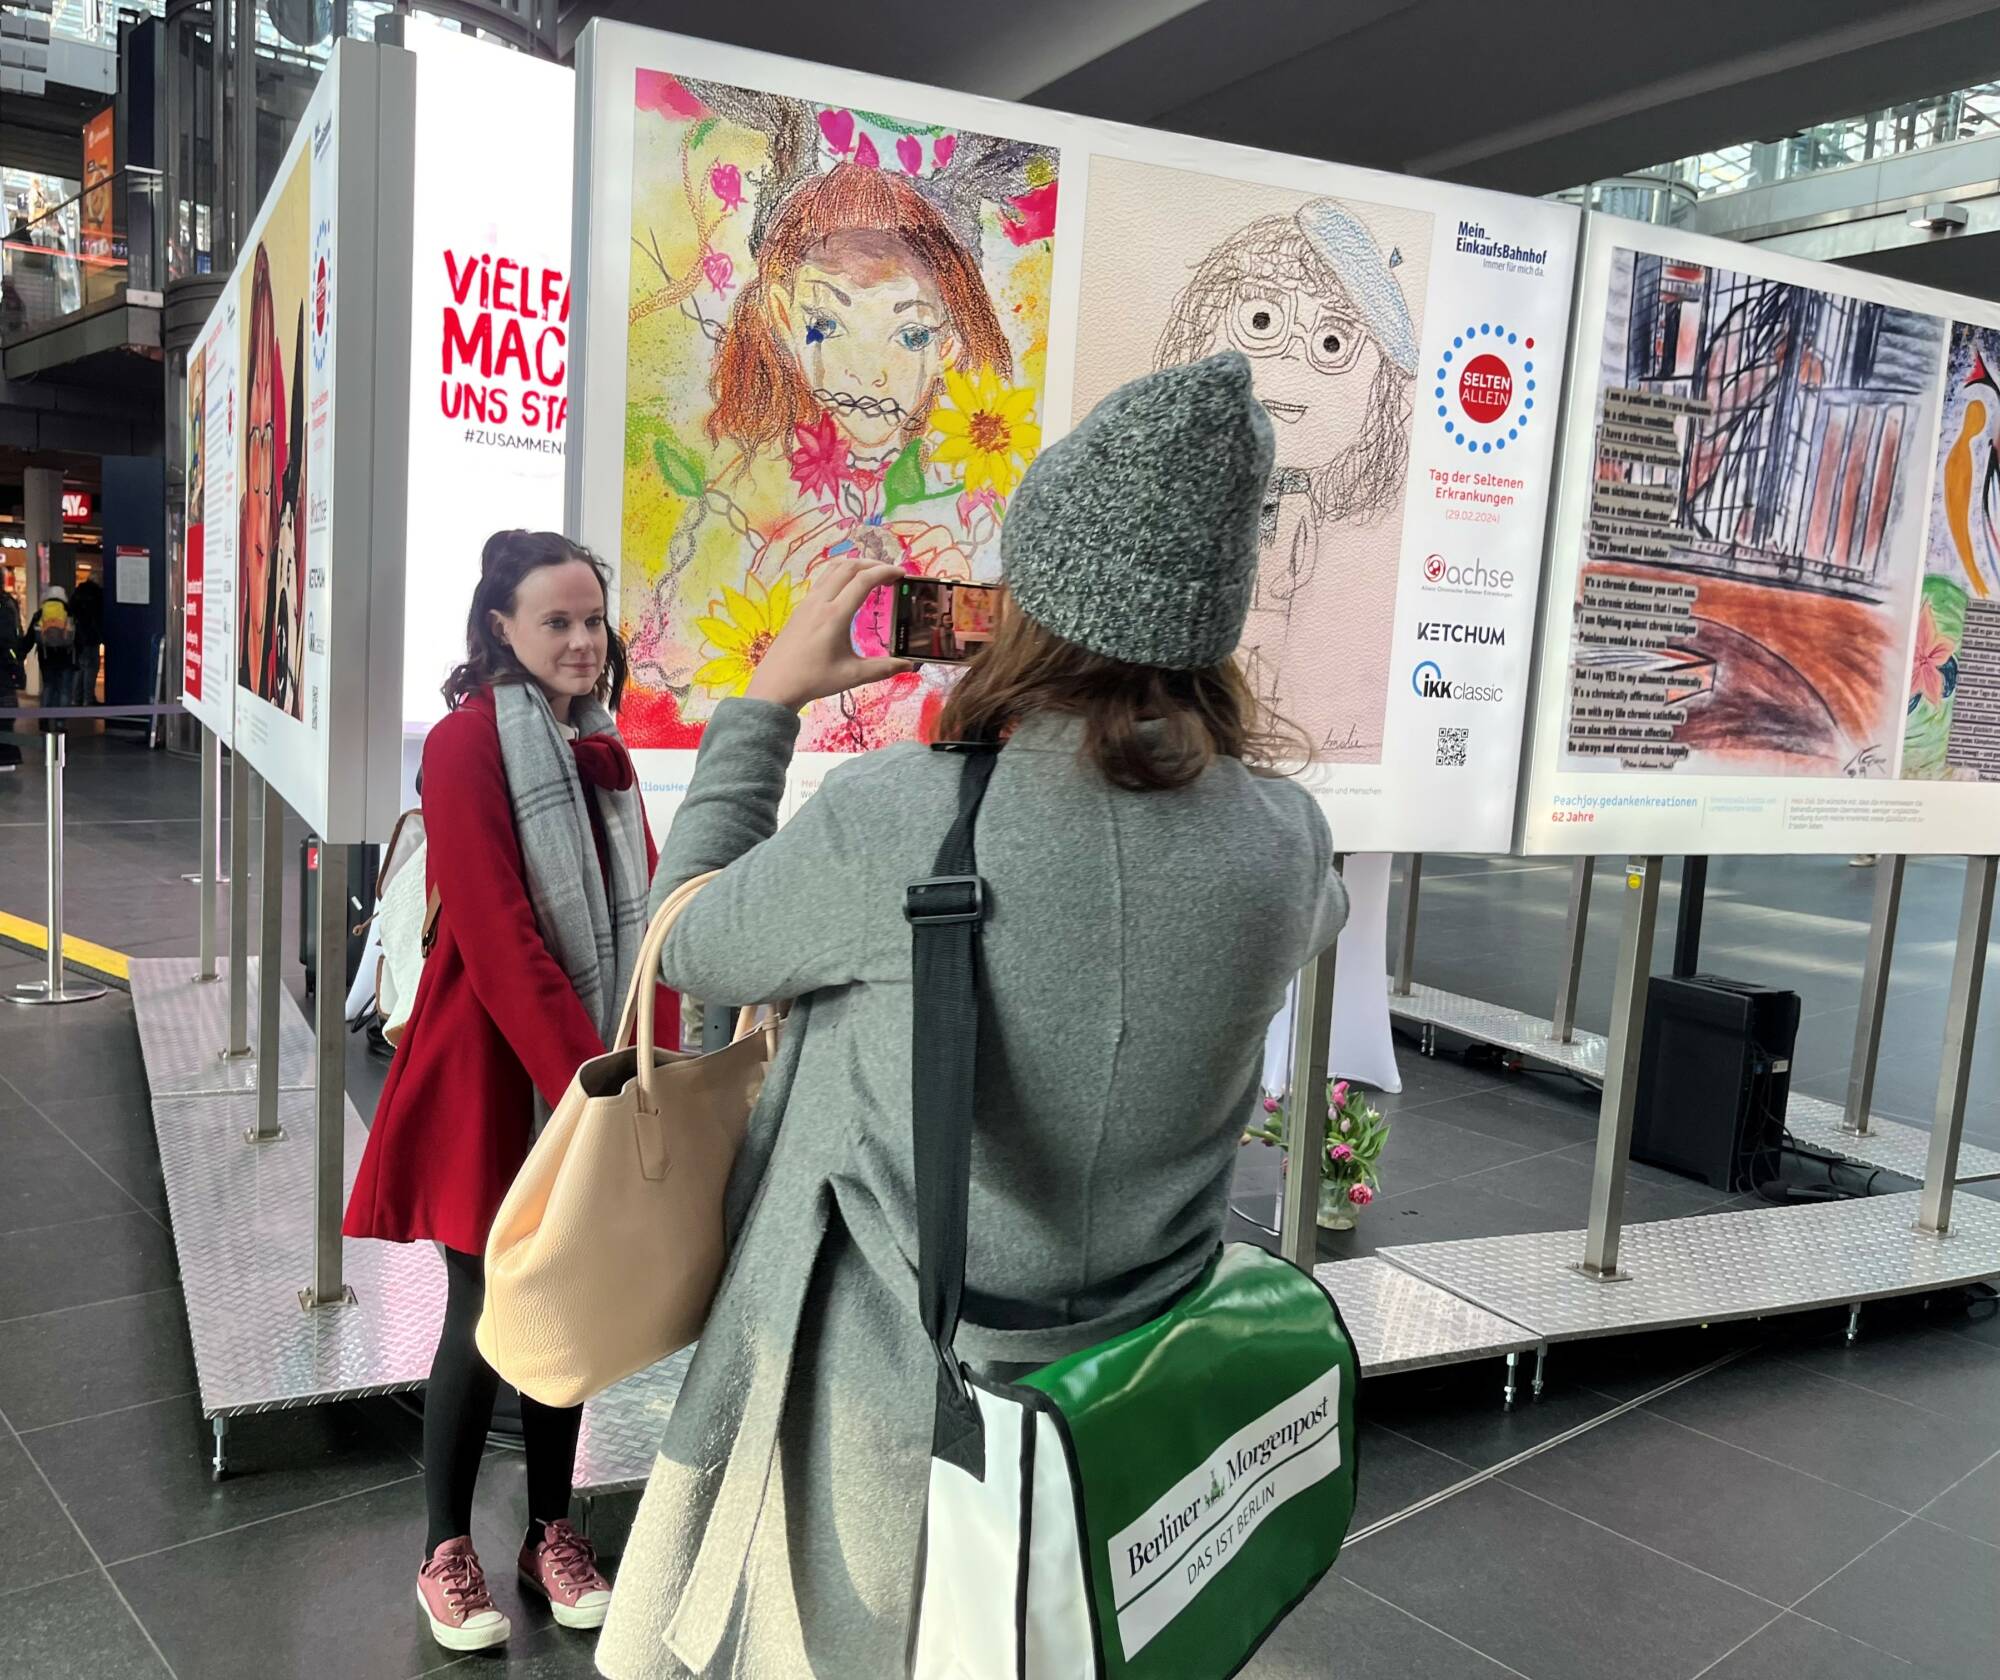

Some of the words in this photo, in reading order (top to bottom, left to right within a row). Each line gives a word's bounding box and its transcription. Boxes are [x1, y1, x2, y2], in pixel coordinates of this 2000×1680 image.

[1456, 237, 1547, 264] EinkaufsBahnhof
[1483, 258, 1505, 271] Immer
[1506, 261, 1516, 272] für
[1517, 265, 1533, 276] mich
[442, 307, 566, 387] MAC
[1463, 371, 1511, 391] SELTEN
[441, 380, 508, 424] UNS
[1461, 388, 1509, 406] ALLEIN
[1618, 411, 1642, 423] chronic
[1629, 432, 1653, 445] chronic
[1620, 449, 1644, 461] chronic
[1429, 468, 1449, 485] Tag
[1452, 470, 1471, 484] der
[1473, 473, 1524, 489] Seltenen
[1435, 487, 1514, 507] Erkrankungen
[1445, 509, 1500, 524] (29.02.2024)
[1617, 506, 1641, 518] chronic
[1624, 525, 1649, 537] chronic
[1597, 543, 1607, 553] my
[1446, 557, 1514, 589] achse
[1602, 579, 1627, 591] chronic
[1628, 581, 1653, 593] disease
[1655, 586, 1666, 597] you
[1583, 595, 1596, 606] This
[1598, 597, 1622, 609] chronic
[1624, 599, 1652, 611] sickness
[1653, 602, 1667, 613] that
[1585, 616, 1595, 624] am
[1597, 614, 1621, 630] fighting
[1624, 618, 1648, 631] against
[1649, 620, 1673, 632] chronic
[1417, 622, 1505, 646] KETCHUM
[1608, 635, 1628, 646] would
[1630, 636, 1637, 647] be
[1645, 638, 1666, 648] dream
[1575, 668, 1586, 679] But
[1592, 671, 1603, 683] say
[1605, 671, 1617, 681] YES
[1618, 671, 1625, 682] to
[1627, 674, 1636, 685] my
[1667, 676, 1702, 689] chronically
[1592, 688, 1628, 703] chronically
[1576, 708, 1586, 716] am
[1588, 708, 1602, 717] with
[1604, 709, 1614, 720] my
[1615, 708, 1626, 718] life
[1627, 708, 1651, 720] chronic
[1574, 725, 1586, 734] can
[1587, 724, 1601, 734] also
[1603, 725, 1617, 735] with
[1618, 726, 1642, 737] chronic
[1644, 728, 1672, 738] affection
[1568, 742, 1576, 752] Be
[1578, 742, 1601, 755] always
[1603, 743, 1615, 753] and
[1616, 743, 1640, 754] eternal
[1641, 744, 1665, 756] chronic
[1666, 745, 1689, 760] happily
[1553, 795, 1698, 809] Peachjoy.gedankenkreationen
[1552, 812, 1564, 822] 62
[1566, 812, 1594, 822] Jahre
[1127, 1498, 1201, 1578] Berliner
[1226, 1395, 1329, 1488] Morgenpost
[1187, 1545, 1213, 1585] DAS
[1216, 1525, 1235, 1556] IST
[1237, 1482, 1276, 1535] BERLIN
